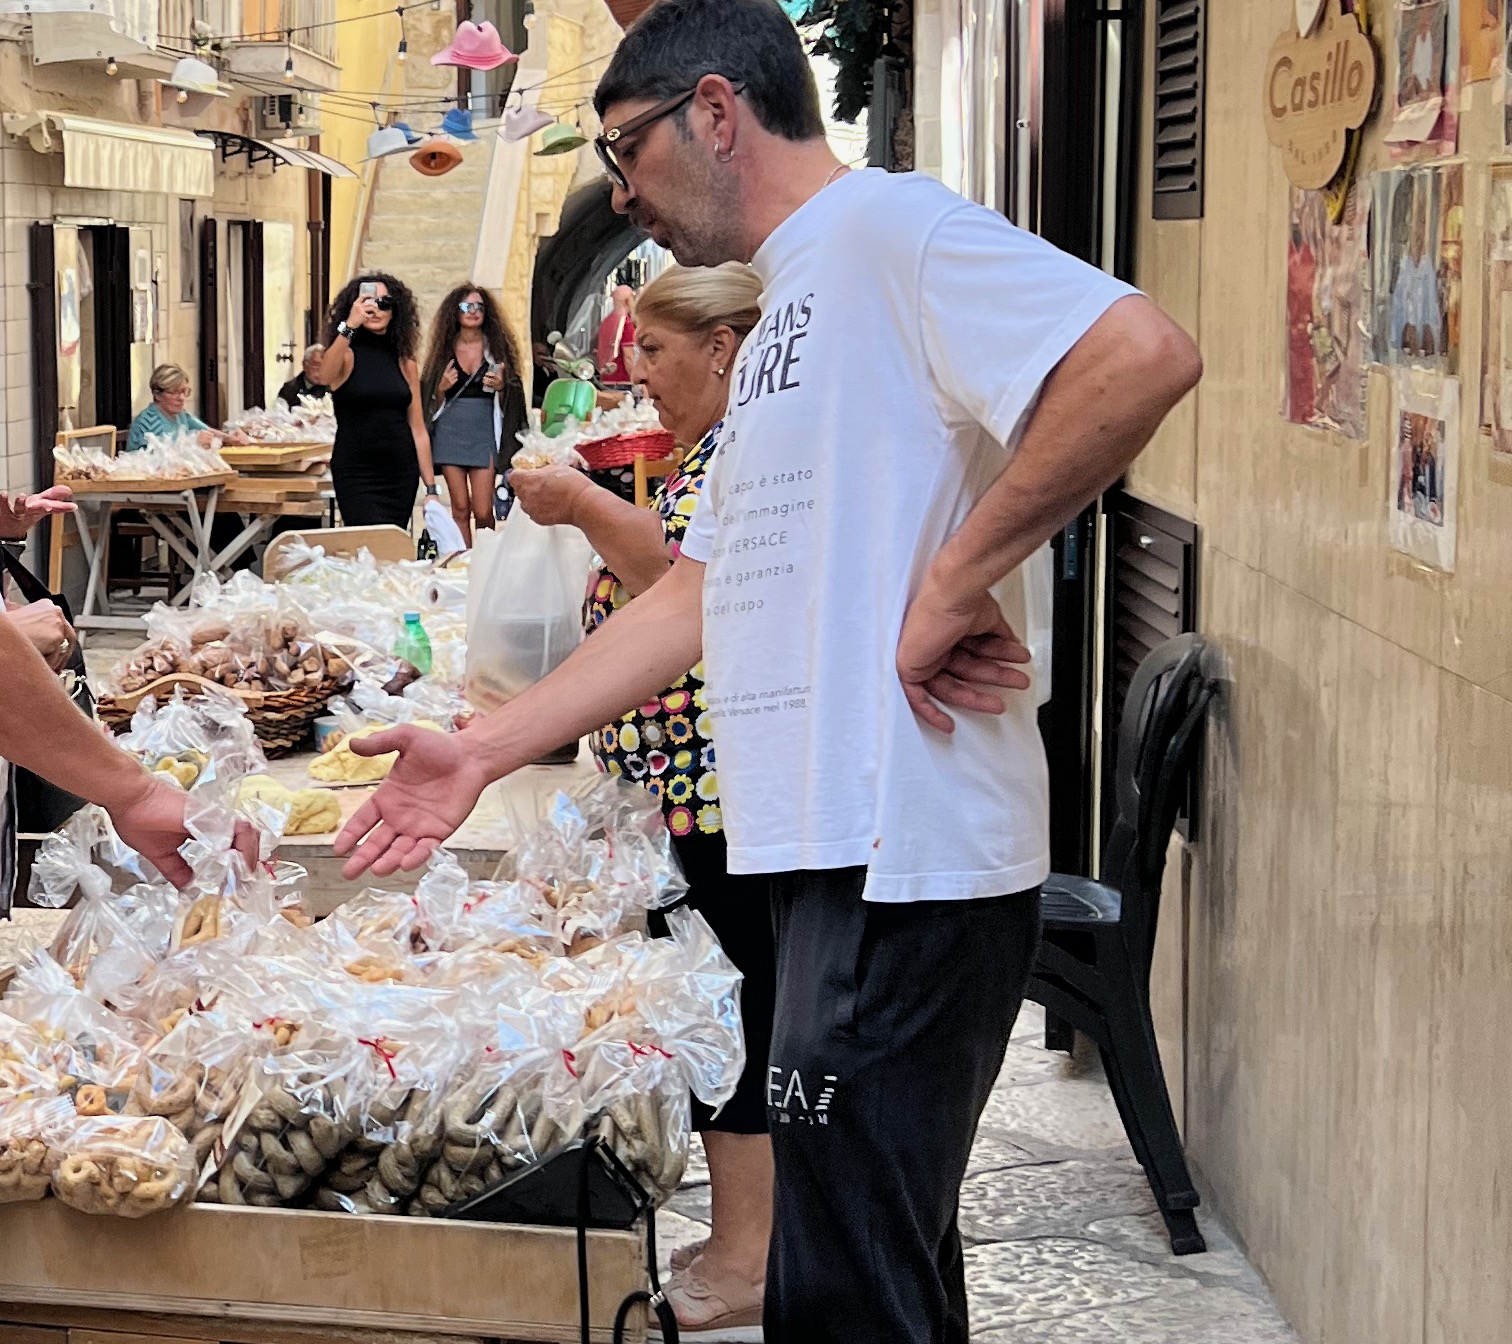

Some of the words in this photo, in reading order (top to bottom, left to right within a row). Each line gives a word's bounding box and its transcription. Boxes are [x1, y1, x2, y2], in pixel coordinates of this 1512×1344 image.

[1269, 39, 1364, 119] Casillo
[737, 331, 808, 407] URE
[773, 469, 814, 485] stato
[728, 530, 789, 554] VERSACE
[737, 562, 795, 587] garanzia
[733, 598, 765, 616] capo
